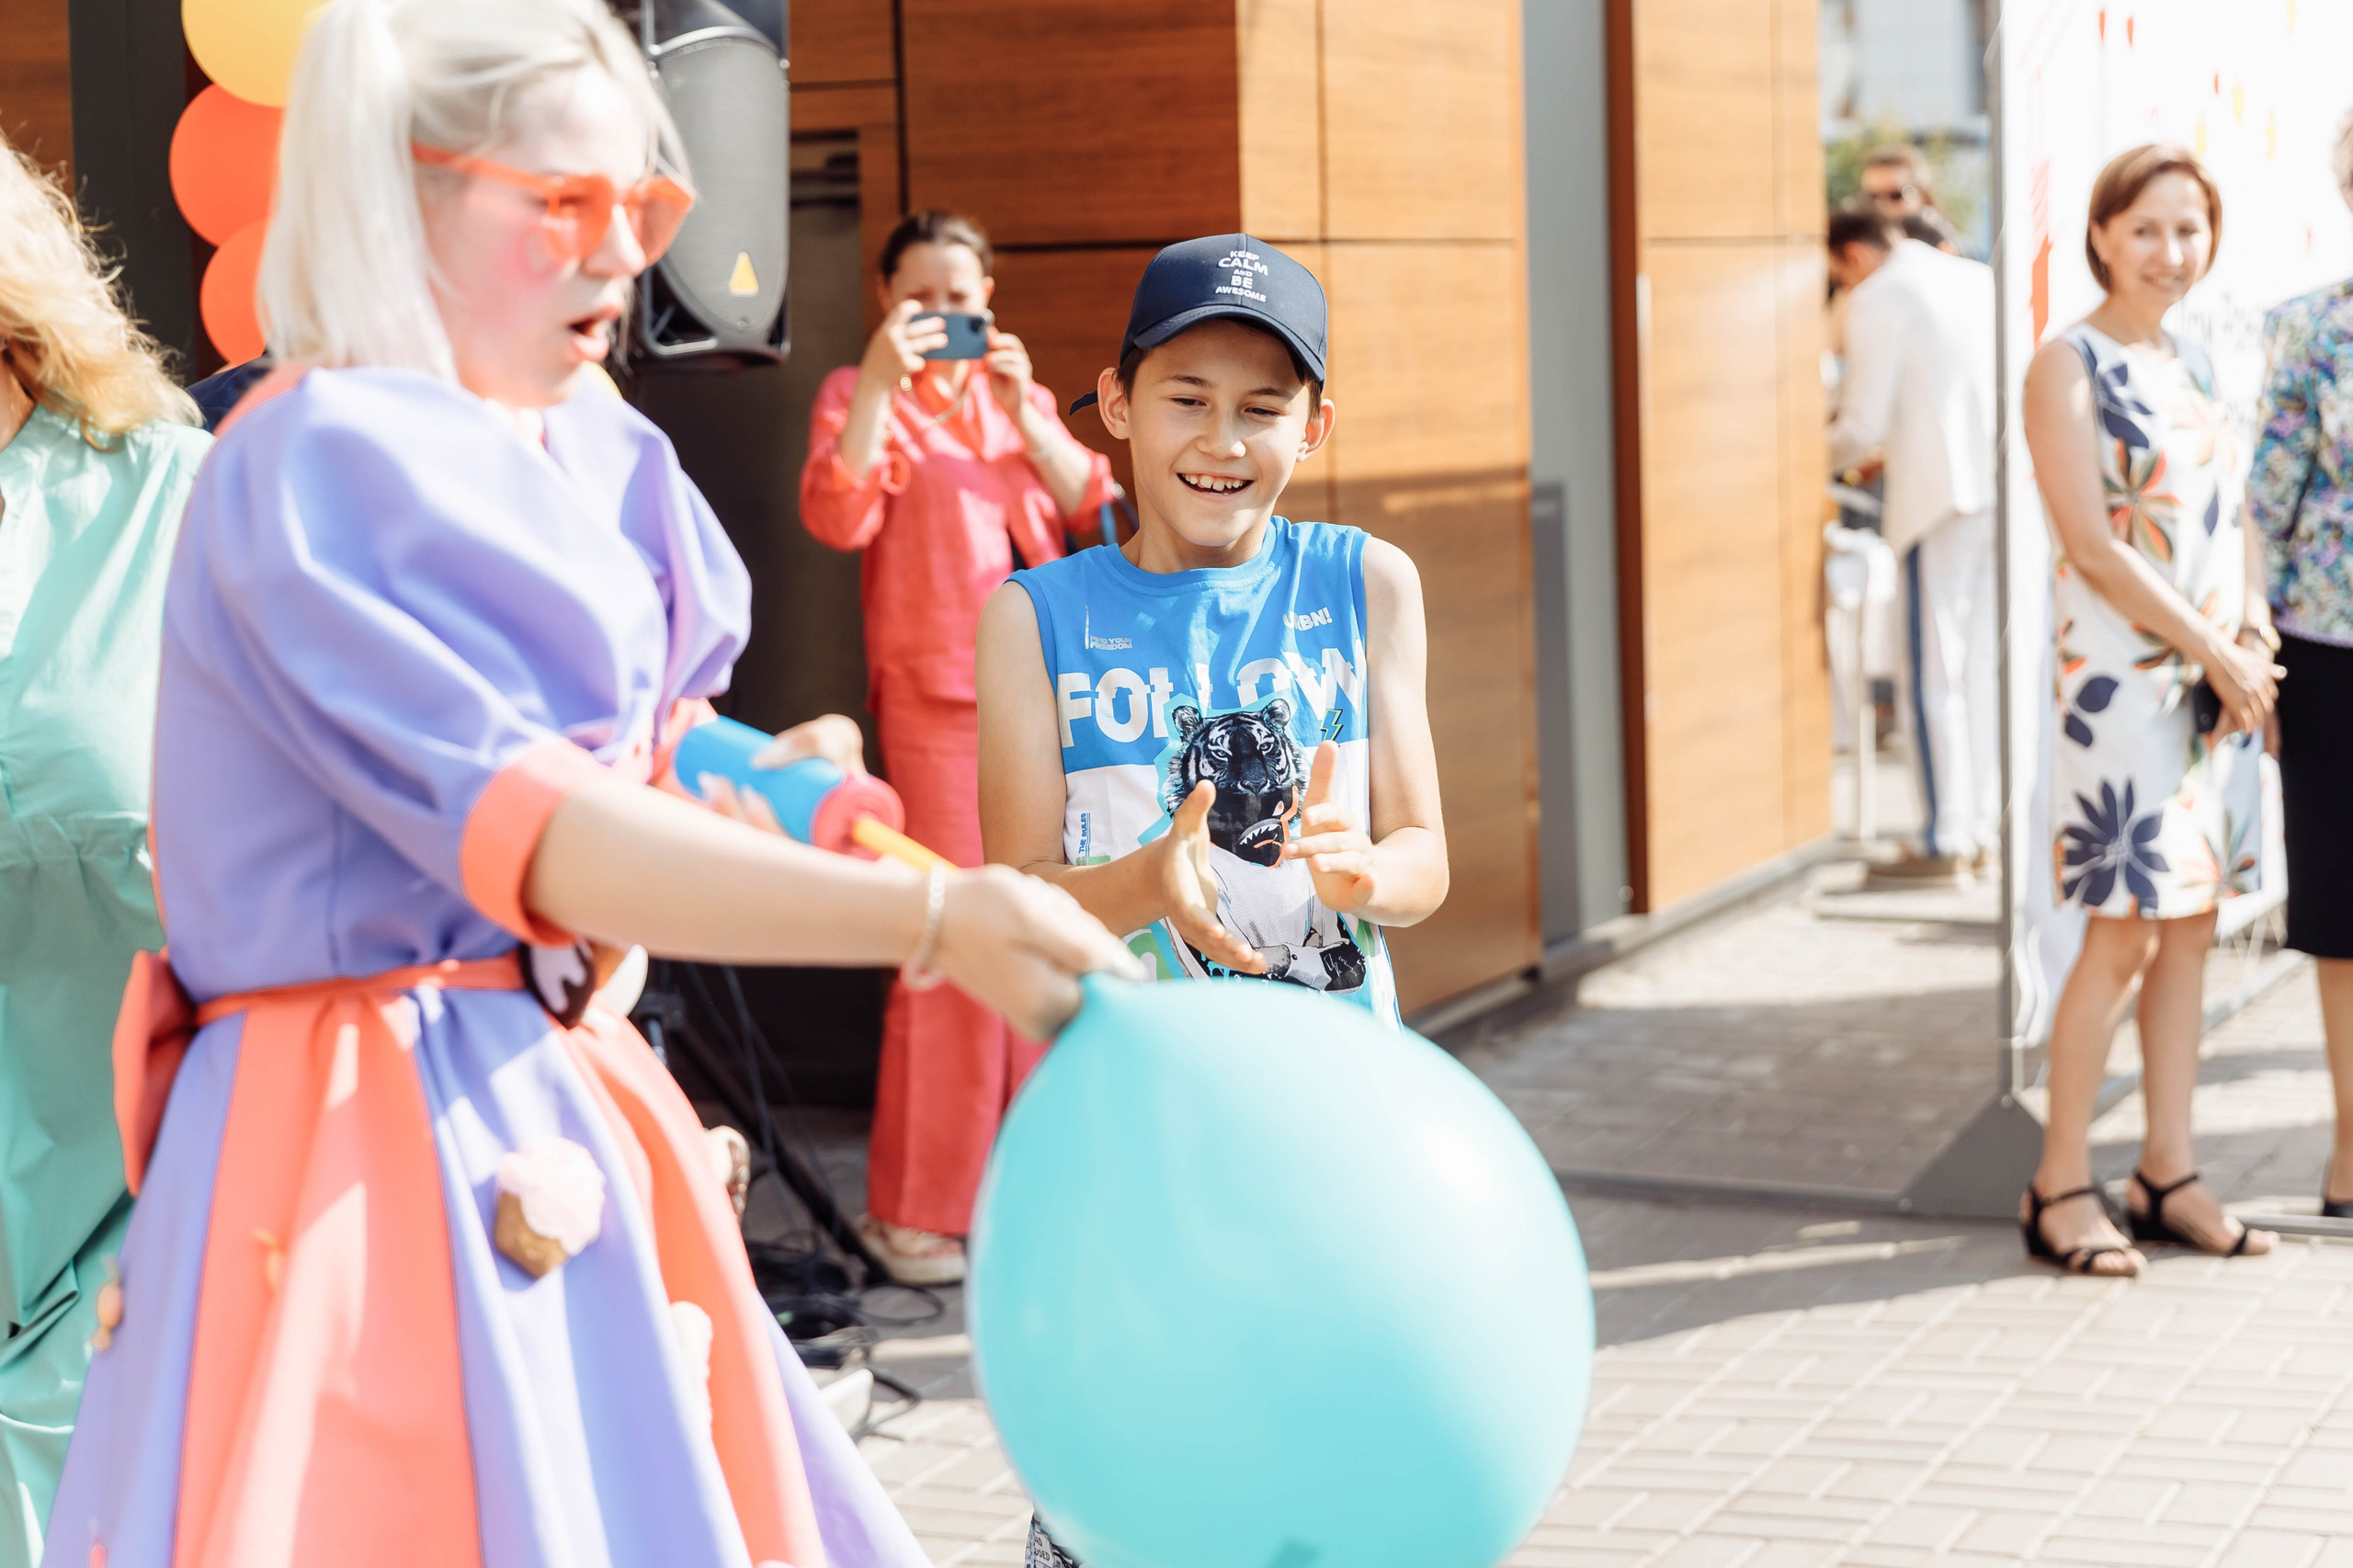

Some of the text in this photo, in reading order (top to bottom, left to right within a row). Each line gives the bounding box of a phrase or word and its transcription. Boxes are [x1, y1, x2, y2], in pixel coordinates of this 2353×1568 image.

[1230, 250, 1260, 261] KEEP
[1218, 257, 1268, 277] CALM
[1233, 268, 1253, 278] AND
[1231, 275, 1253, 290] BE
[1215, 286, 1267, 302] AWESOME
[1078, 838, 1086, 854] THE
